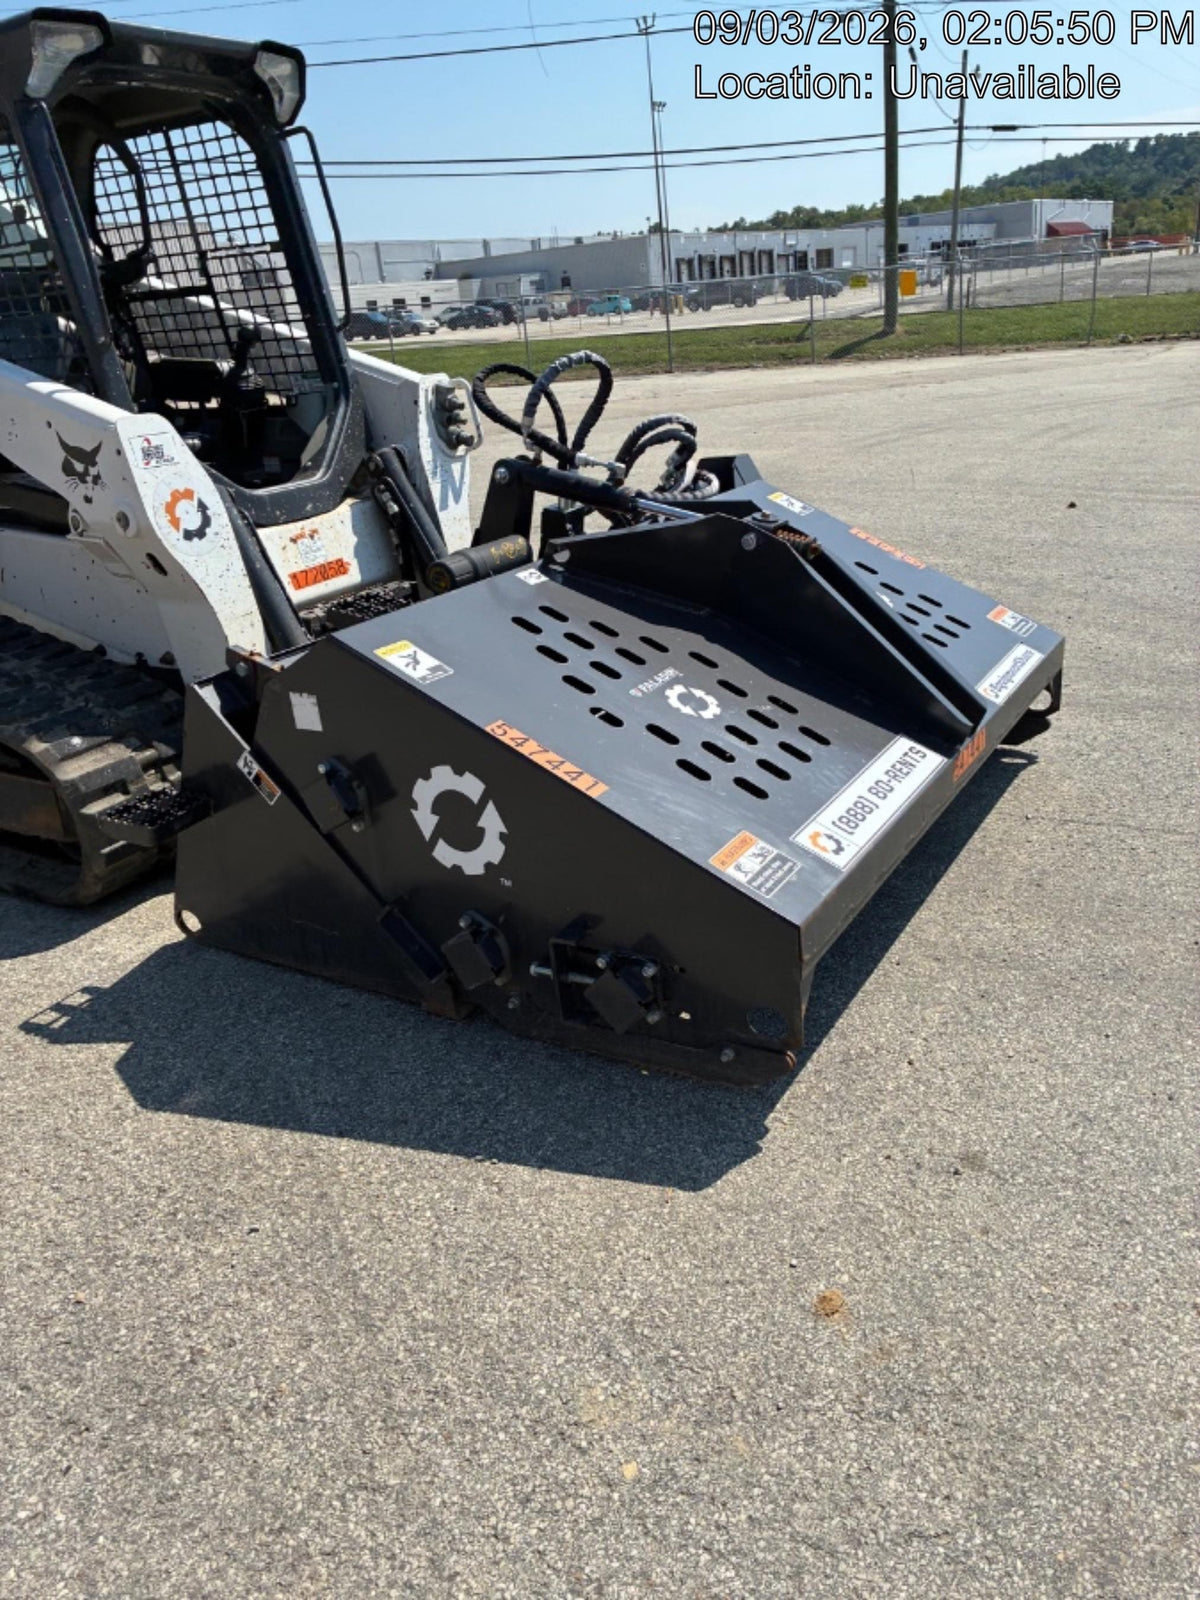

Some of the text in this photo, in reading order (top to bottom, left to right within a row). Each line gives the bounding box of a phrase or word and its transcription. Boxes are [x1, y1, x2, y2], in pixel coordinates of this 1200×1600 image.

[490, 722, 600, 792] 547441
[831, 745, 928, 836] (888) 80-RENTS
